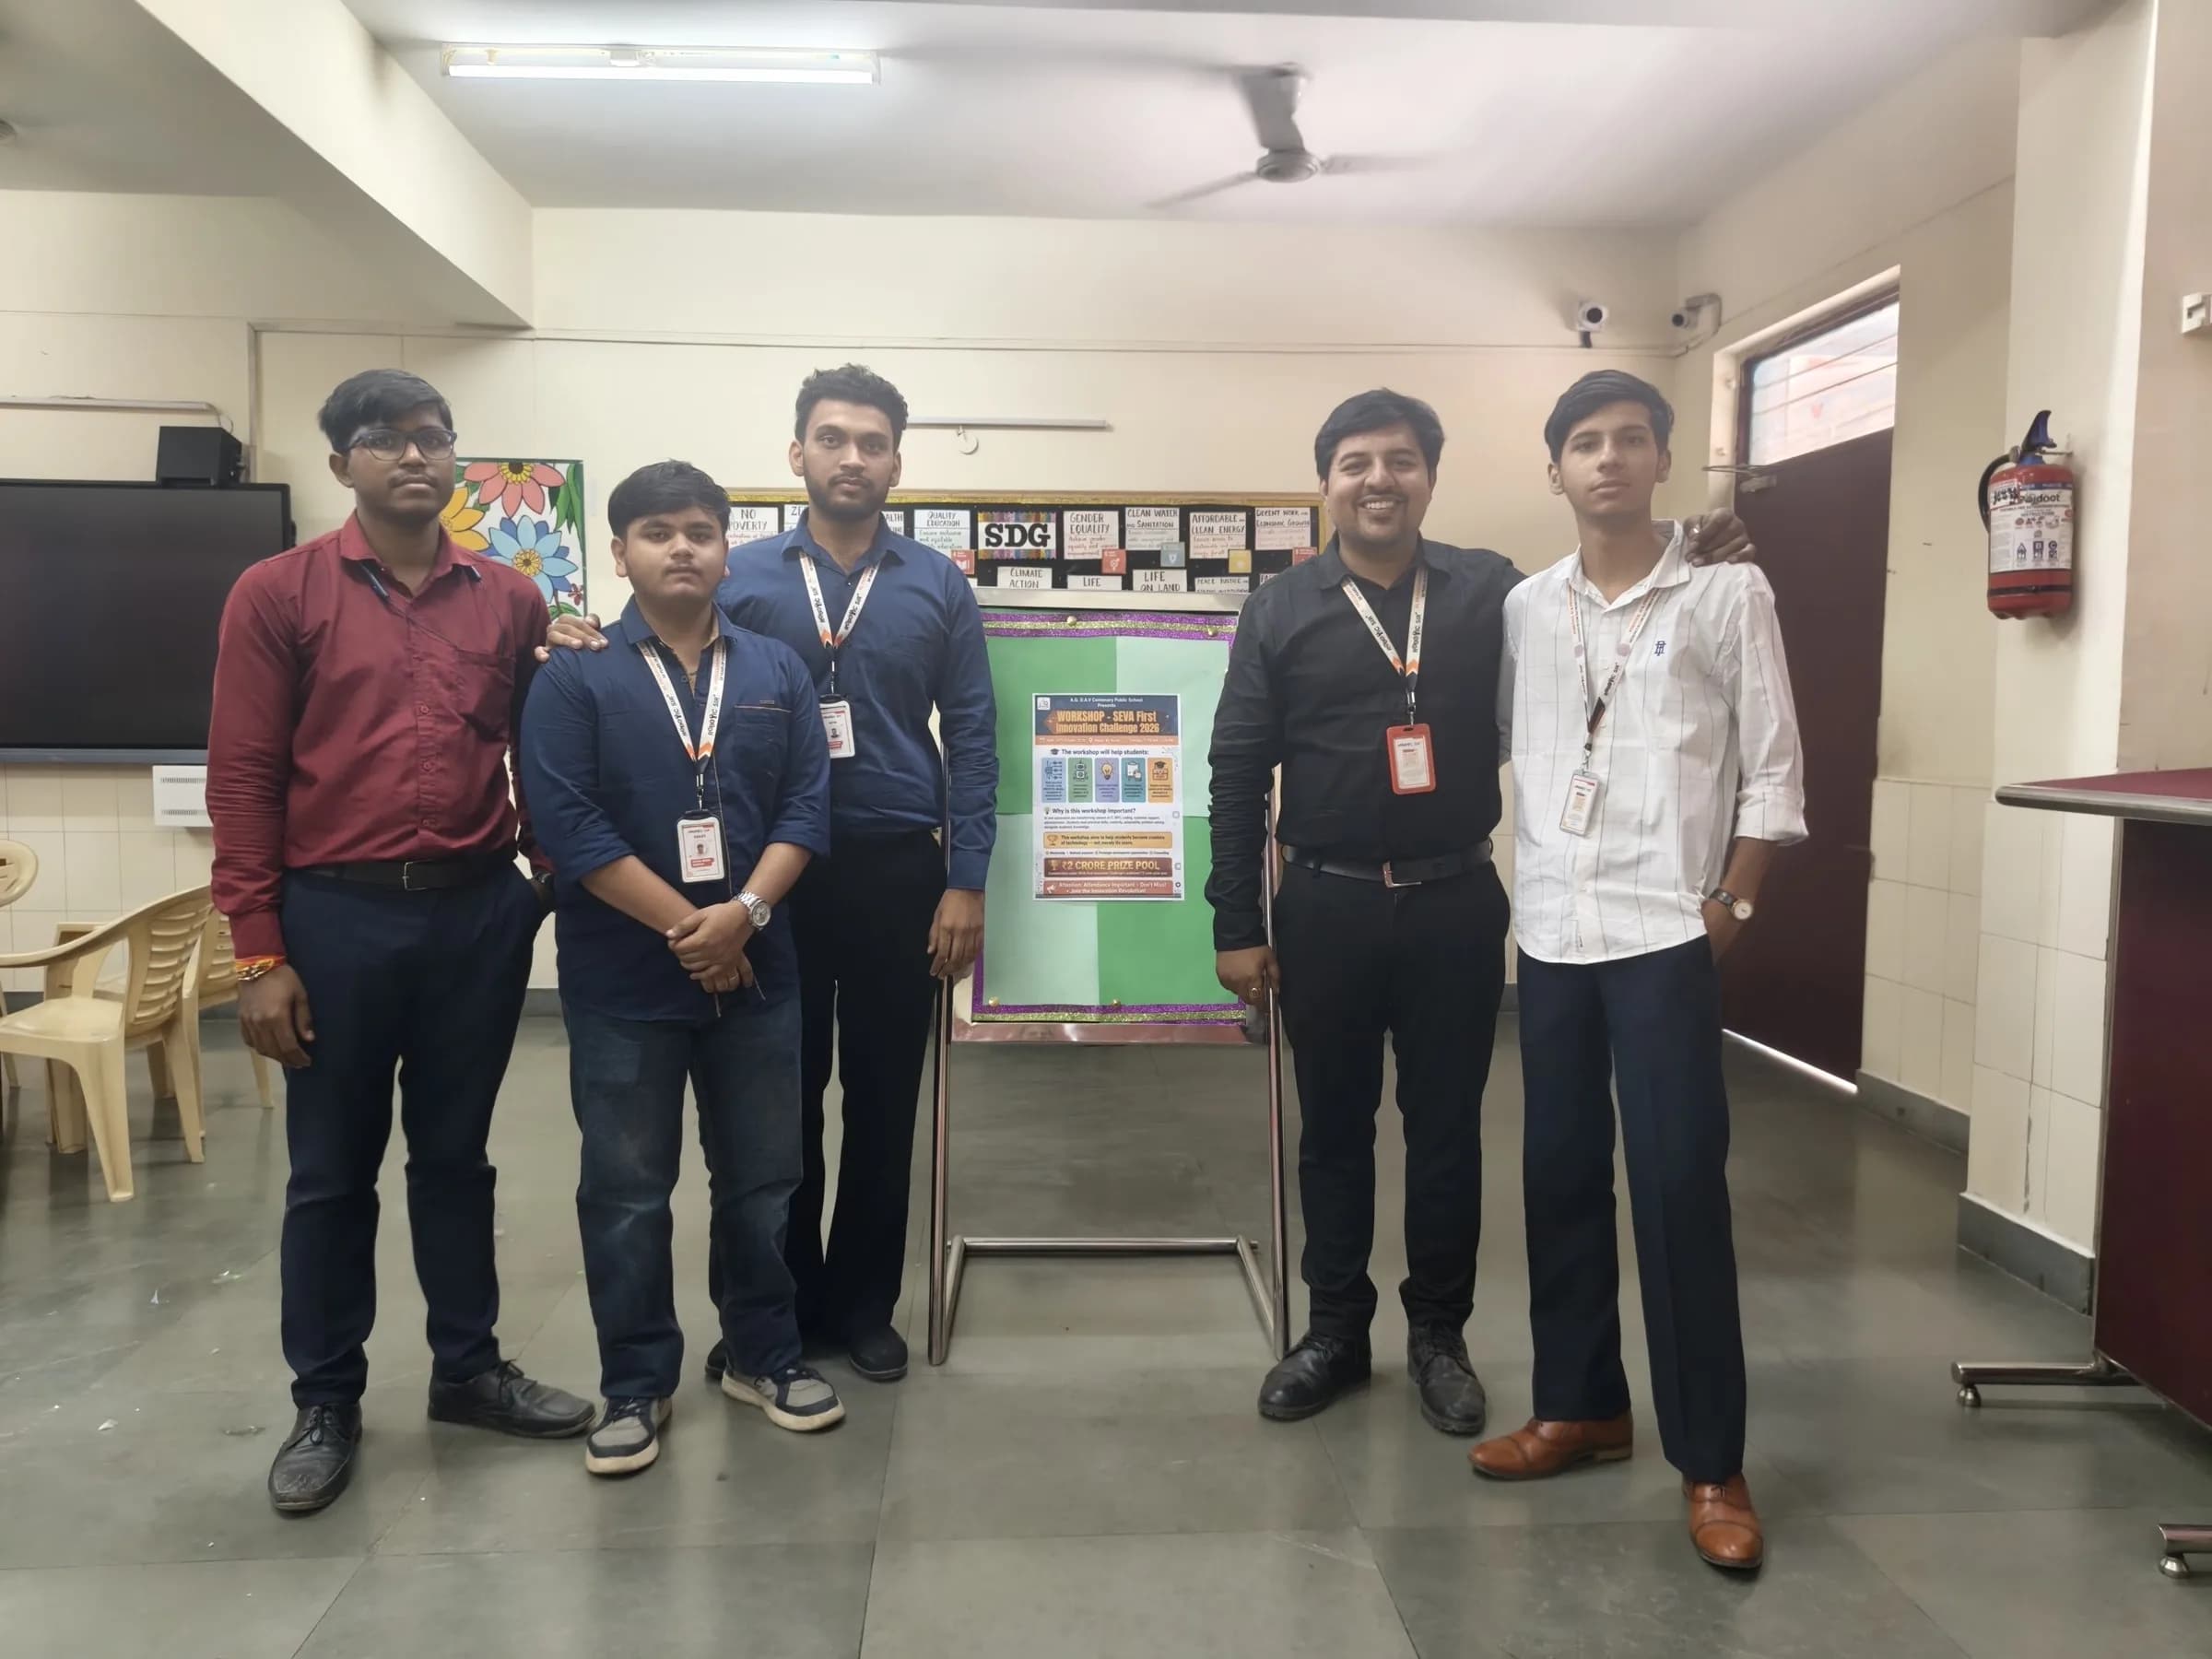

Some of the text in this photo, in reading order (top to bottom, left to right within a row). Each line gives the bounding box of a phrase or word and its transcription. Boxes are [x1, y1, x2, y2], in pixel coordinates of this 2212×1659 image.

[741, 509, 757, 520] NO
[929, 511, 957, 519] QUALITY
[1069, 512, 1105, 523] GENDER
[1127, 509, 1178, 517] CLEAN WATER
[1136, 520, 1174, 528] SANITATION
[1192, 514, 1238, 524] AFFORDABLE
[1070, 524, 1110, 535] EQUALITY
[1191, 525, 1245, 535] CLEAN ENERGY
[984, 523, 1051, 547] SDG
[1010, 568, 1042, 578] CLIMATE
[1144, 571, 1166, 582] LIFE
[1009, 580, 1039, 588] ACTION
[1083, 576, 1101, 587] LIFE
[1158, 583, 1181, 592] LAND
[1056, 711, 1105, 723] WORKSHOP
[1112, 711, 1135, 723] SEVA
[1136, 711, 1157, 723] First
[1055, 723, 1159, 735] Innovation Challenge 2026
[1075, 861, 1106, 870] CRORE
[1107, 861, 1135, 870] PRIZE
[1135, 861, 1160, 870] POOL
